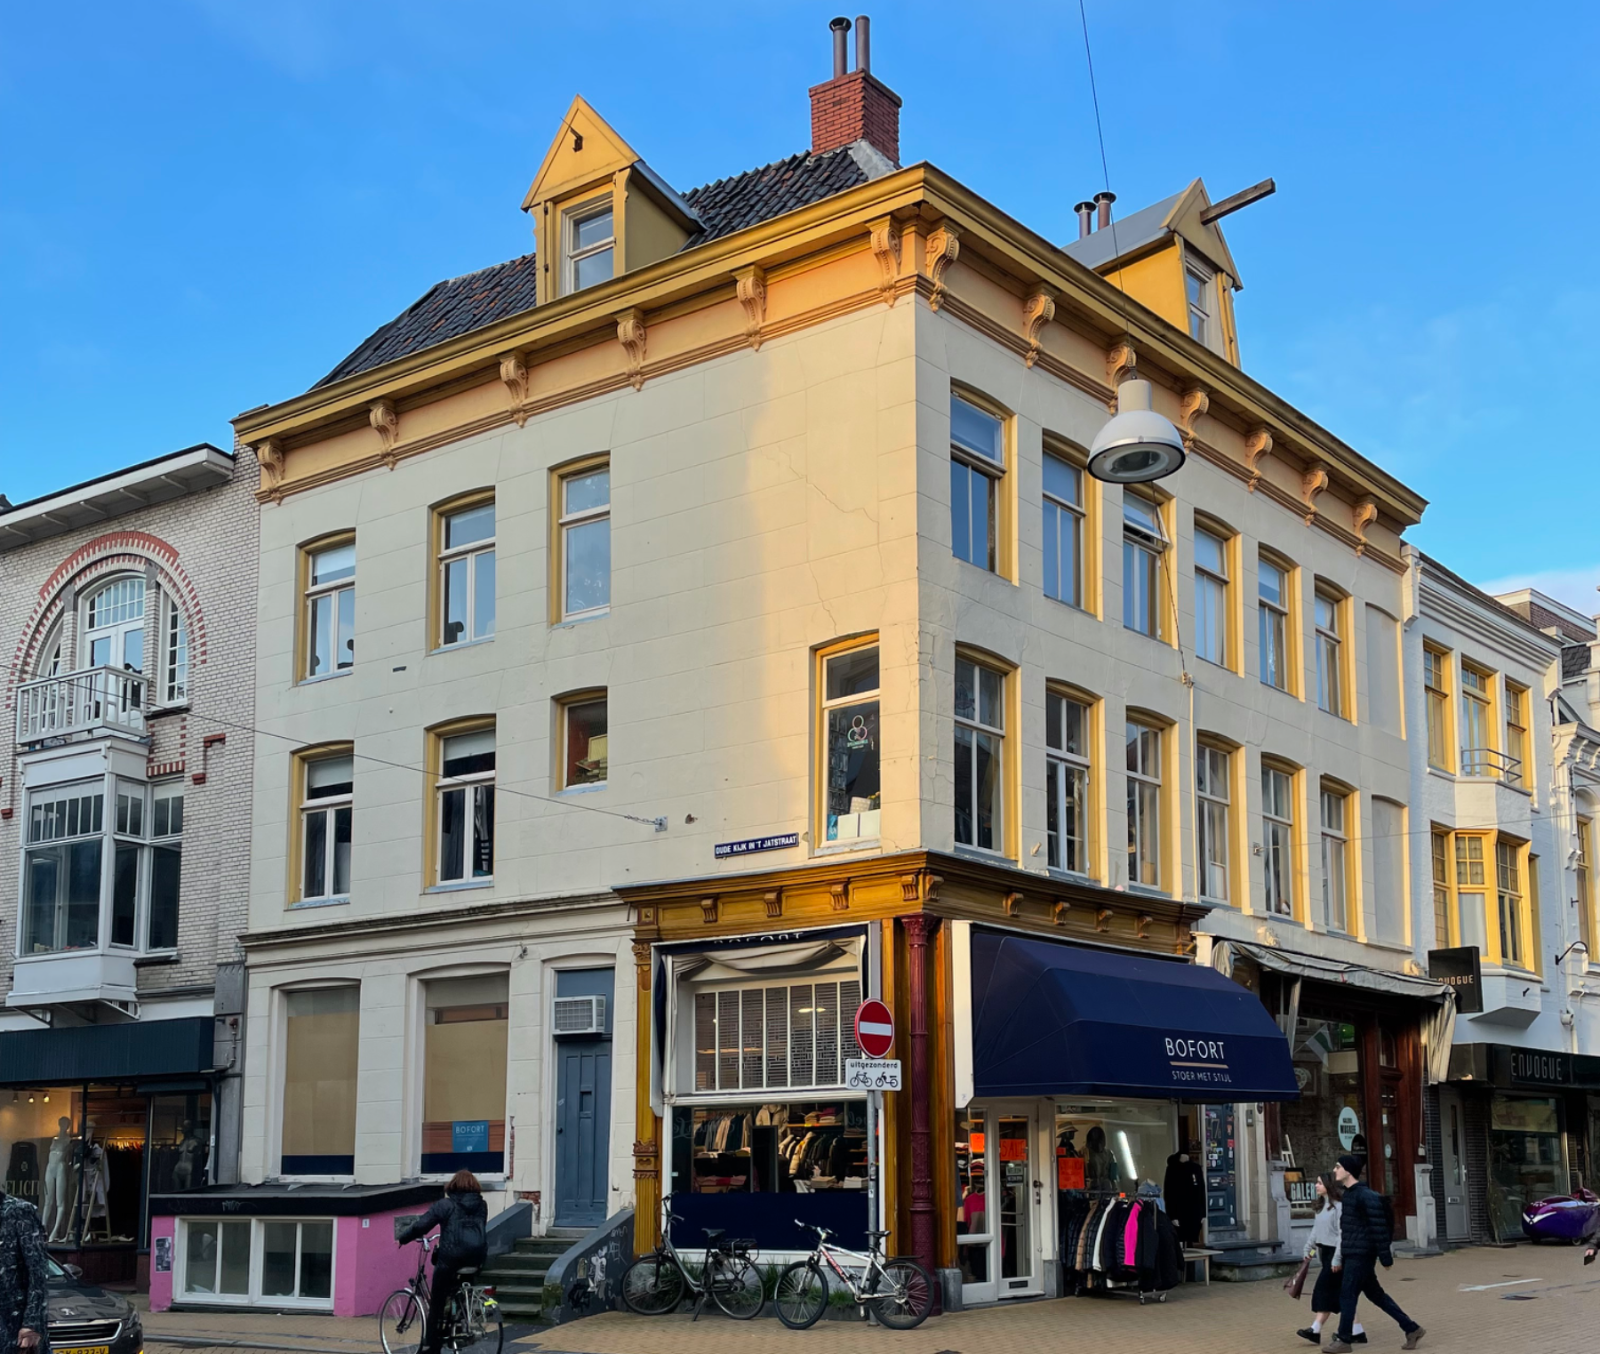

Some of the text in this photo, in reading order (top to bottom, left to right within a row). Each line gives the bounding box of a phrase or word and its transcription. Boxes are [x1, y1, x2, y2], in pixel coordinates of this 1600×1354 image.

[715, 845, 731, 855] OUDE
[733, 842, 747, 852] KIJK
[748, 841, 755, 850] IN
[763, 835, 797, 848] JATSTRAAT
[1165, 1037, 1224, 1059] BOFORT
[850, 1061, 898, 1069] uitgezonderd
[1171, 1070, 1232, 1083] STOER MET STIJL
[455, 1125, 485, 1134] BOFORT
